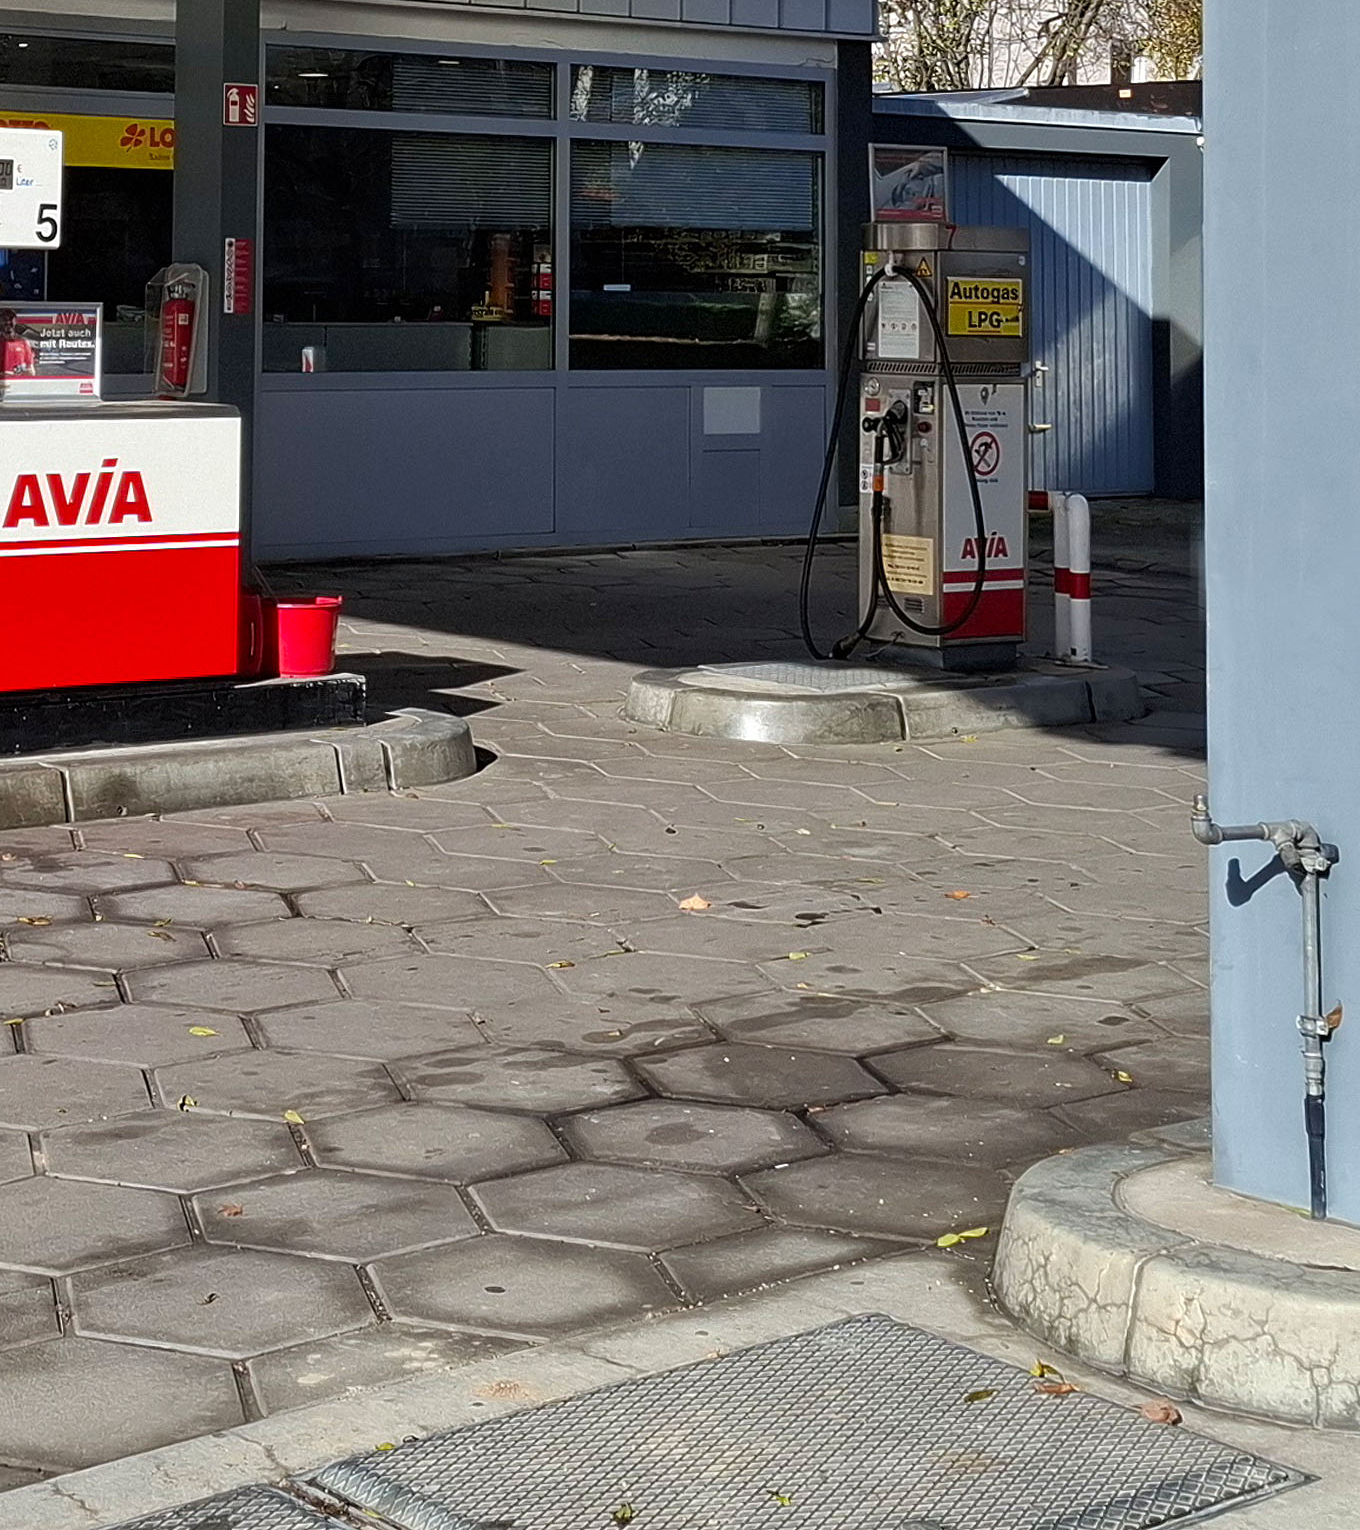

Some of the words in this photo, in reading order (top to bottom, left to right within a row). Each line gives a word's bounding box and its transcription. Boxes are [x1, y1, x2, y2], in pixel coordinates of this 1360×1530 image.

[35, 203, 58, 243] 5
[945, 224, 957, 250] 7
[950, 281, 1019, 303] Autogas
[968, 310, 1001, 329] LPG
[40, 328, 65, 338] Jetzt
[68, 328, 91, 338] auch
[40, 338, 56, 349] mit
